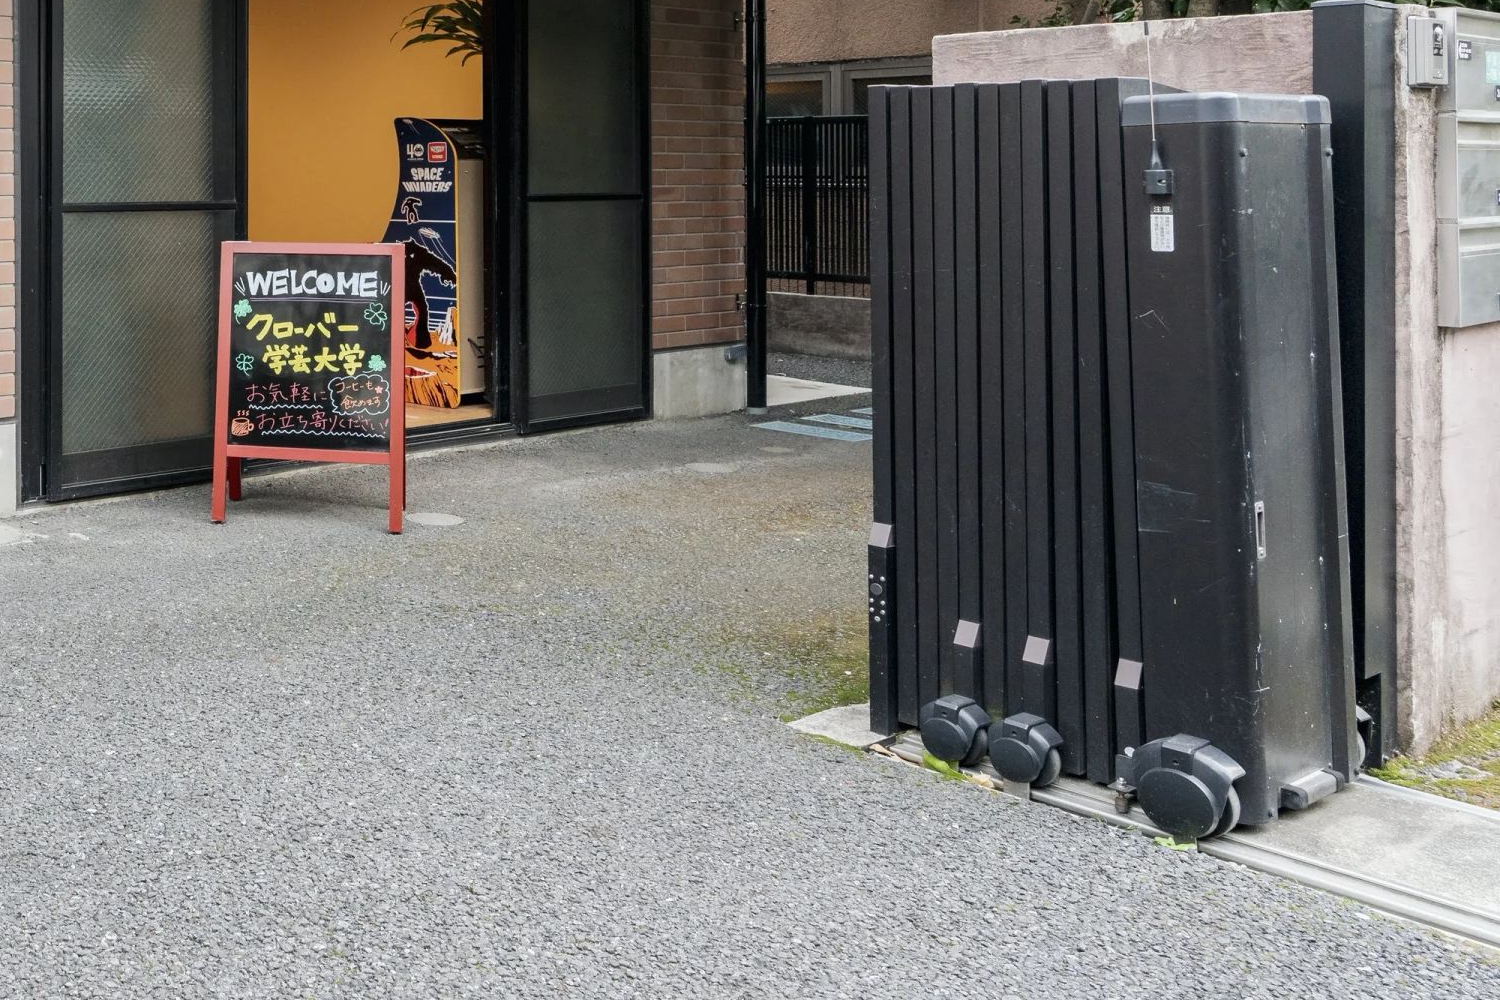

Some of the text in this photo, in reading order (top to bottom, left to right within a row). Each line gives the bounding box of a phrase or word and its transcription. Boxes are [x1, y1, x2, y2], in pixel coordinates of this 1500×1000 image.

[410, 167, 444, 181] SPACE
[401, 181, 453, 193] INVADERS
[246, 268, 378, 297] WELCOME
[246, 312, 359, 341] クローバー
[262, 343, 365, 376] 学芸大学
[245, 382, 327, 404] お気軽に
[335, 381, 374, 393] コーヒーも
[340, 395, 381, 409] 飲めます
